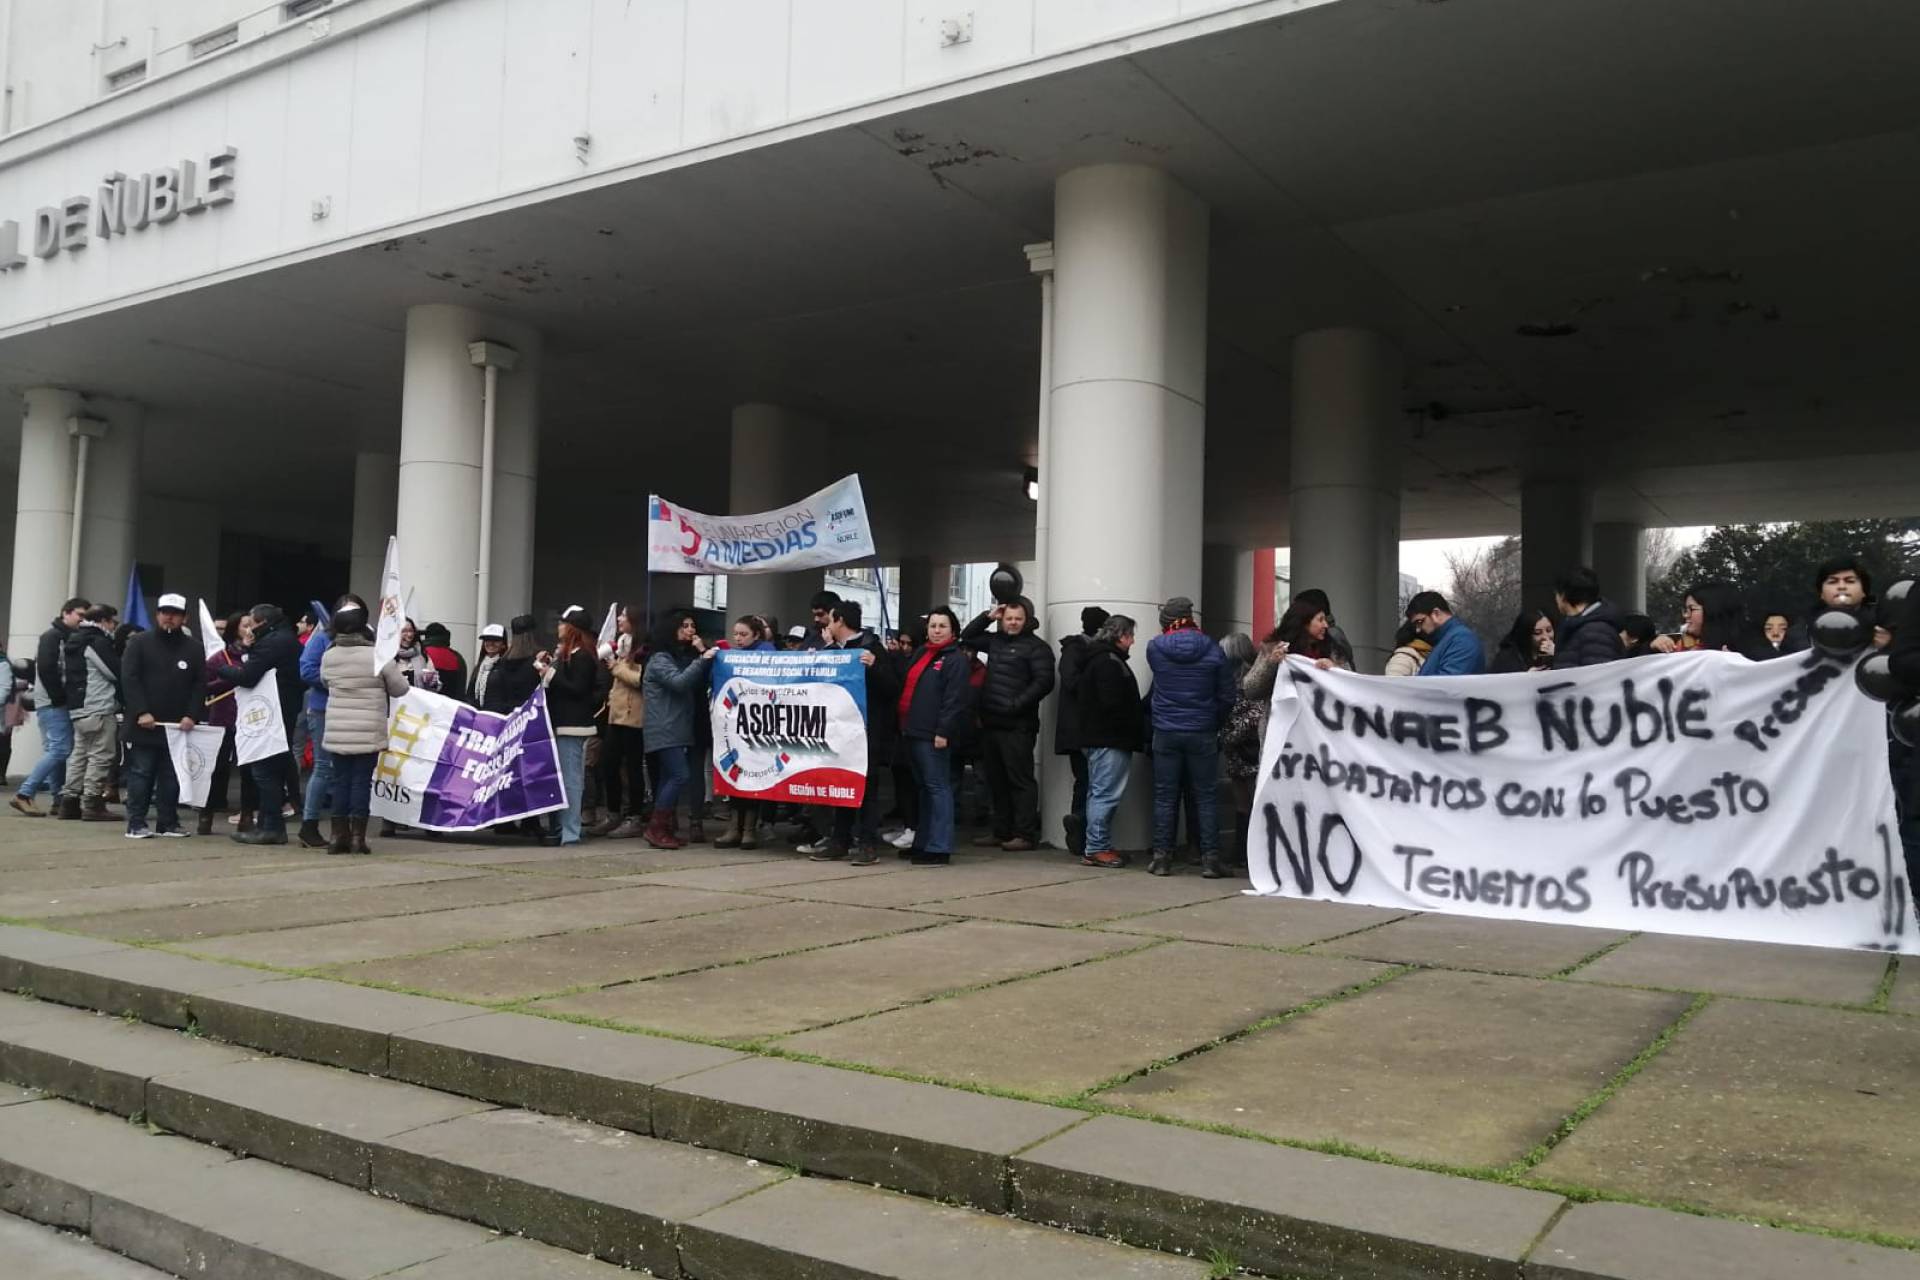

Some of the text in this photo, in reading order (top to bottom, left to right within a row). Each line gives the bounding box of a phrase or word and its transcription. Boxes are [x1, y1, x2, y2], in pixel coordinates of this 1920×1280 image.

[34, 195, 90, 259] DE
[96, 146, 239, 240] ÑUBLE
[704, 520, 818, 566] A MEDIAS
[736, 703, 827, 738] ASOFUMI
[816, 786, 828, 797] DE
[829, 784, 856, 799] ÑUBLE
[1263, 802, 1362, 896] NO
